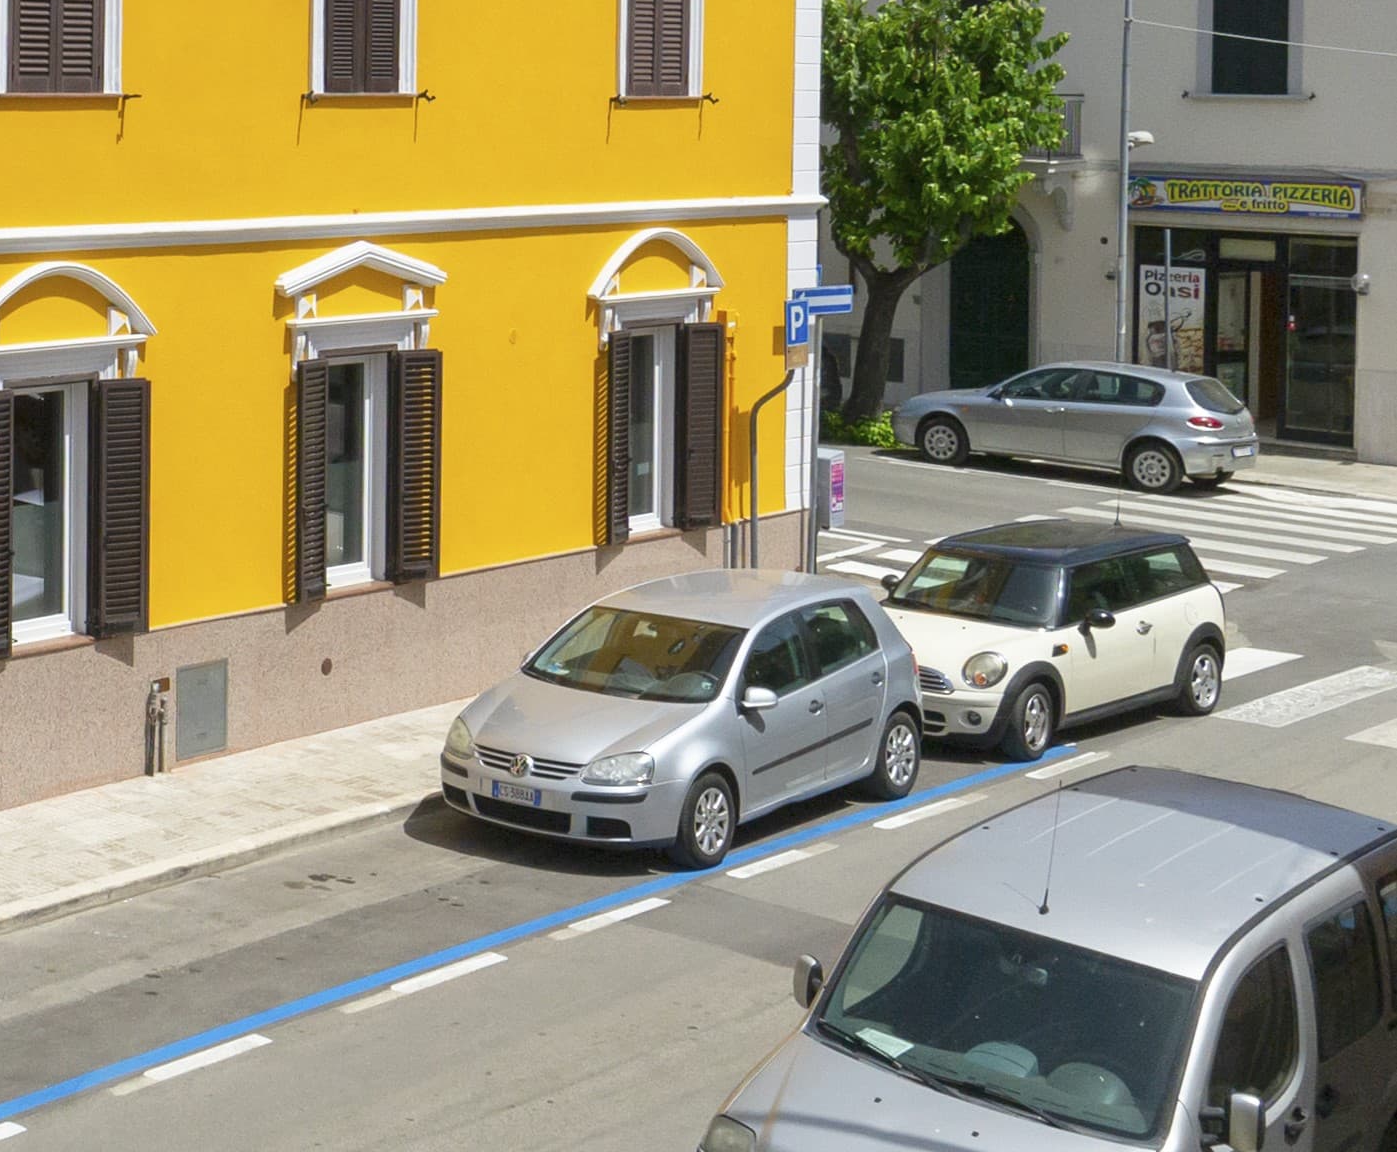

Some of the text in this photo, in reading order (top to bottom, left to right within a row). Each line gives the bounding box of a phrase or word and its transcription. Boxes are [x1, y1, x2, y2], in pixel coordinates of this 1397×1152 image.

[1167, 182, 1352, 207] TRATTORIA PIZZERIA
[1251, 199, 1286, 210] fritto
[1145, 282, 1200, 299] Oasi
[790, 305, 804, 341] P
